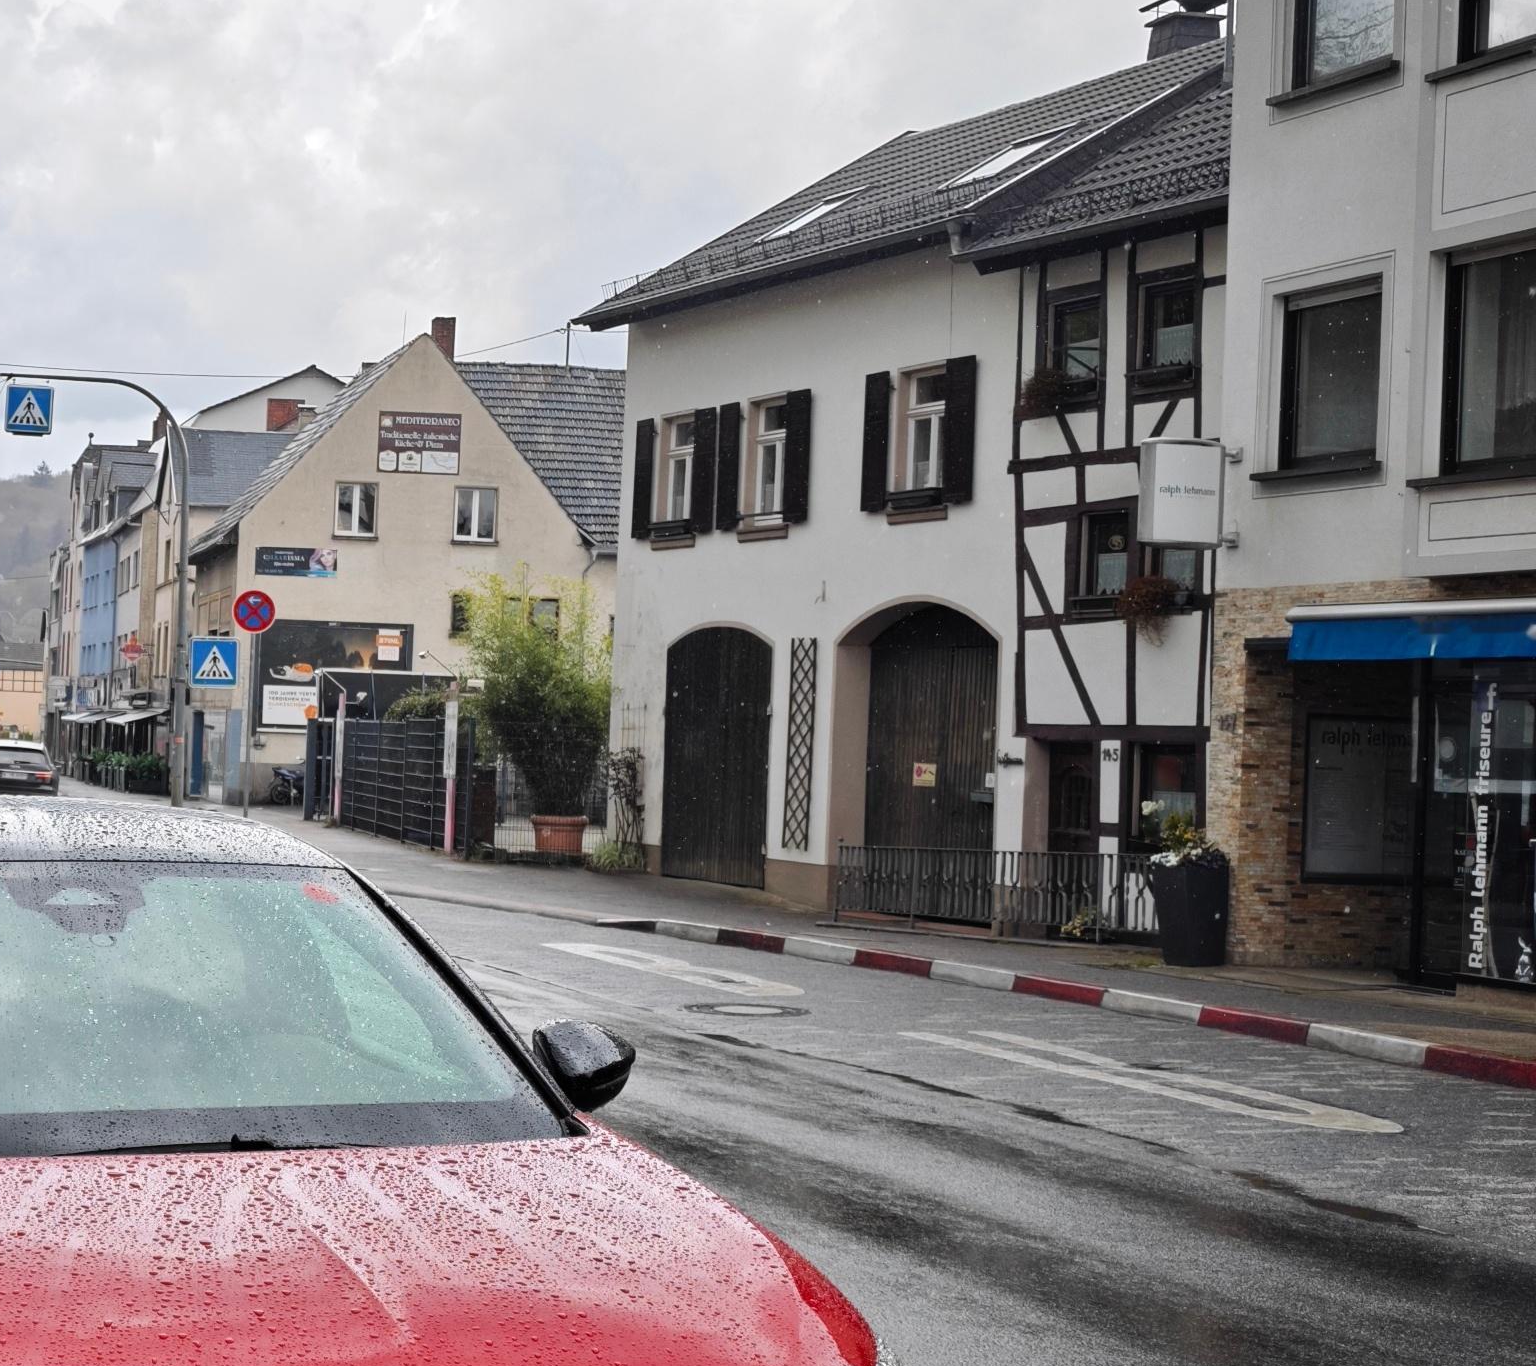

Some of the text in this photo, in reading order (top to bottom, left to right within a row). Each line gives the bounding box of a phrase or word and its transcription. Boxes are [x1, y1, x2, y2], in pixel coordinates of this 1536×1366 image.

[1159, 484, 1216, 498] ralph lehmann
[1321, 726, 1361, 755] ralph
[1101, 747, 1120, 763] 145
[1467, 710, 1494, 969] Ralph lehmann friseure
